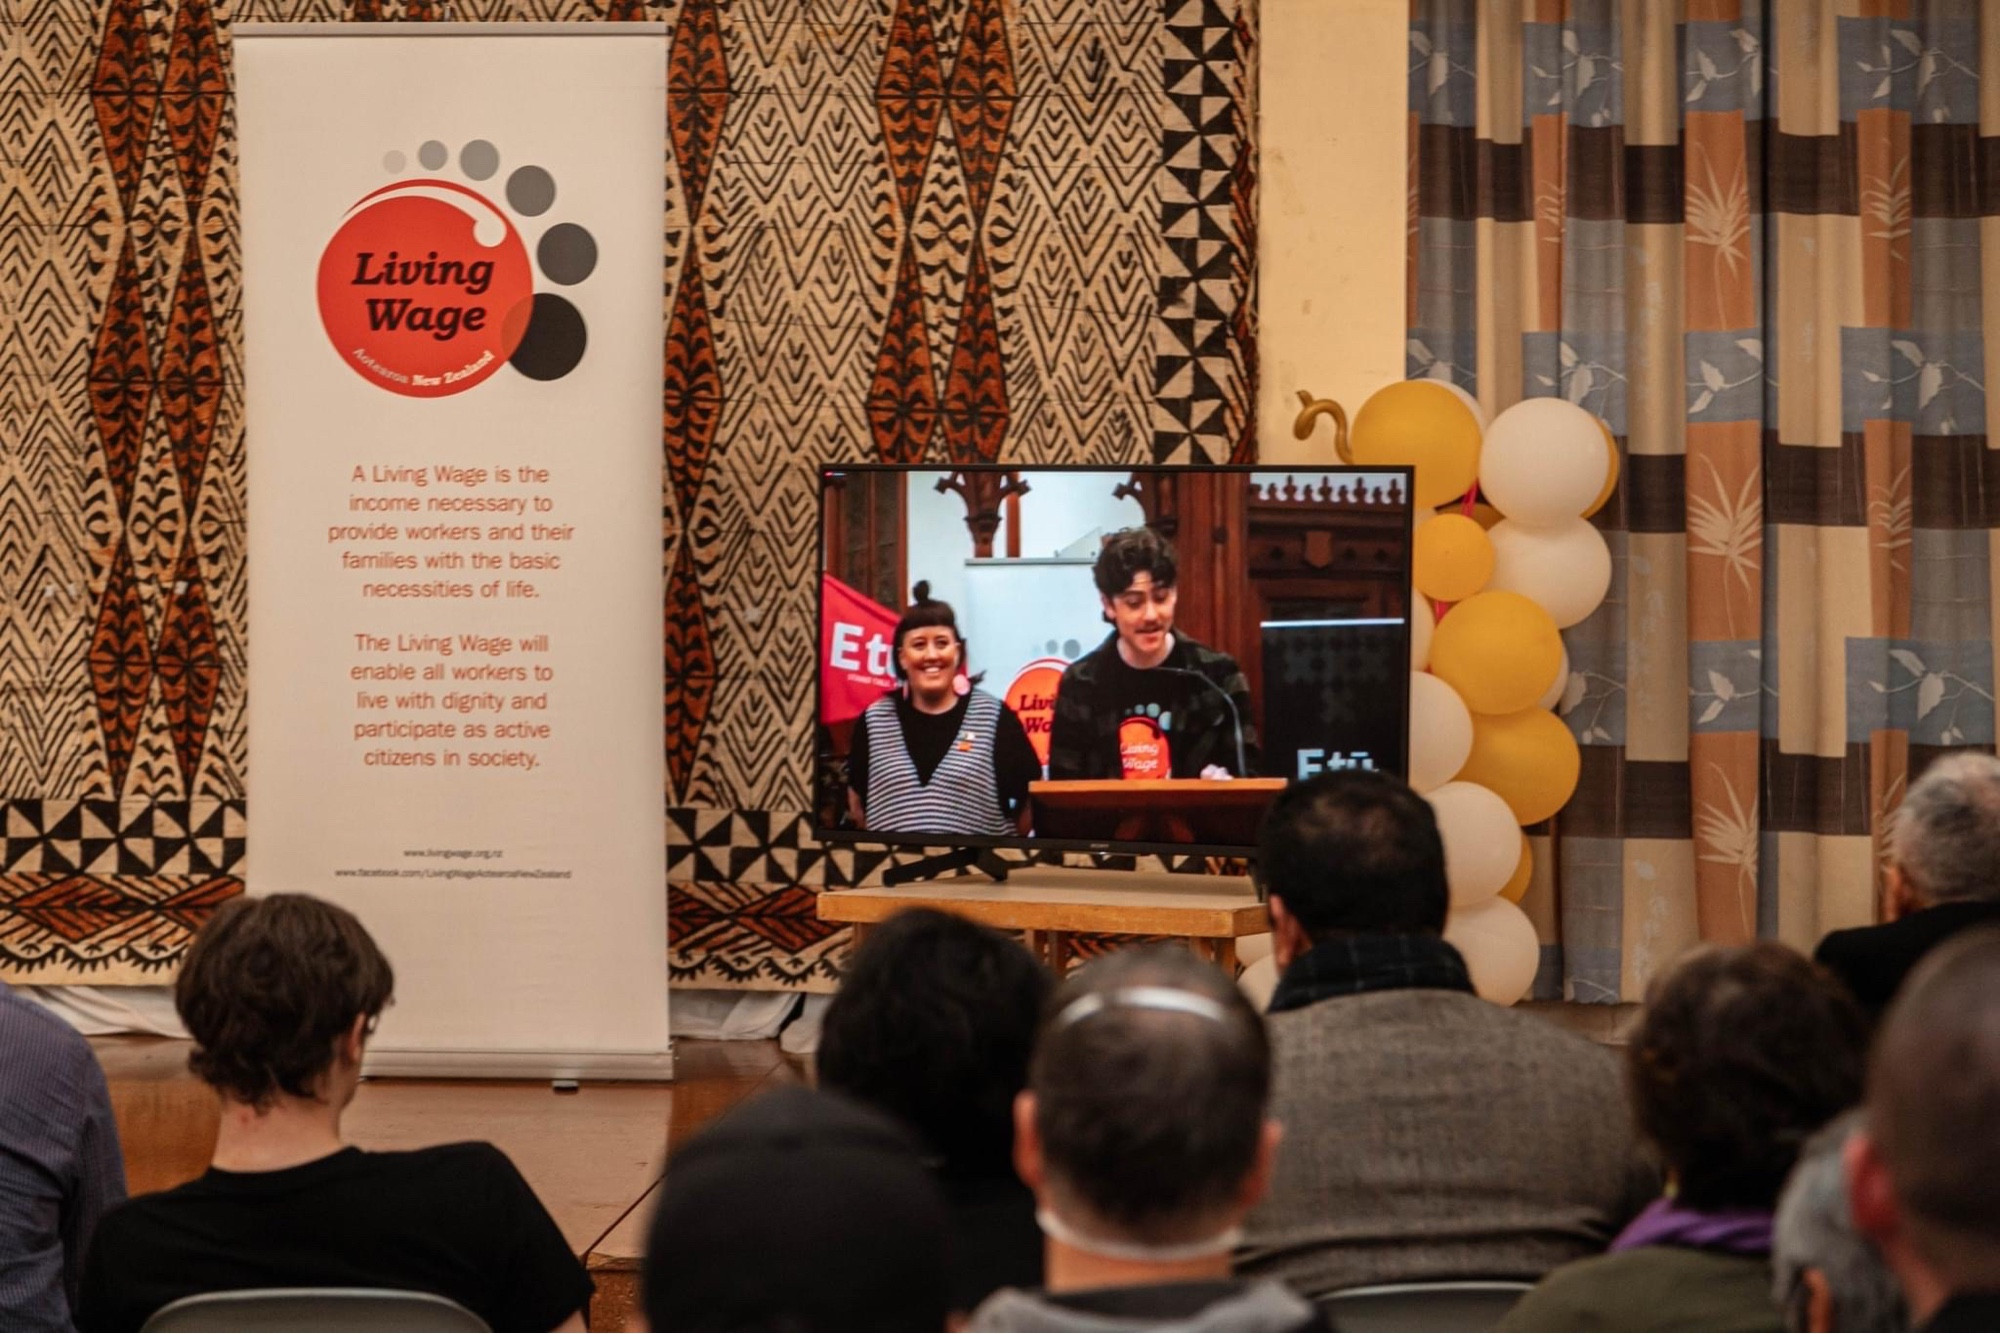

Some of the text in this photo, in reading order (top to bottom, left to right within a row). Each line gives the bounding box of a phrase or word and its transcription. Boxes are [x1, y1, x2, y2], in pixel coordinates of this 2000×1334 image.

[351, 251, 495, 295] Living
[366, 298, 487, 341] Wage
[353, 348, 495, 386] Aotearoa New Zealand
[352, 465, 549, 487] A Living Wage is the
[350, 495, 553, 516] income necessary to
[328, 523, 575, 543] provide workers and their
[342, 551, 560, 569] families with the basic
[363, 580, 539, 598] necessities of life.
[354, 633, 549, 656] The Living Wage will
[350, 664, 554, 681] enable all workers to
[357, 692, 547, 713] live with dignity and
[354, 721, 550, 740] participate as active
[364, 749, 540, 770] citizens in society.
[404, 849, 503, 860] www.livingwage.org.nz
